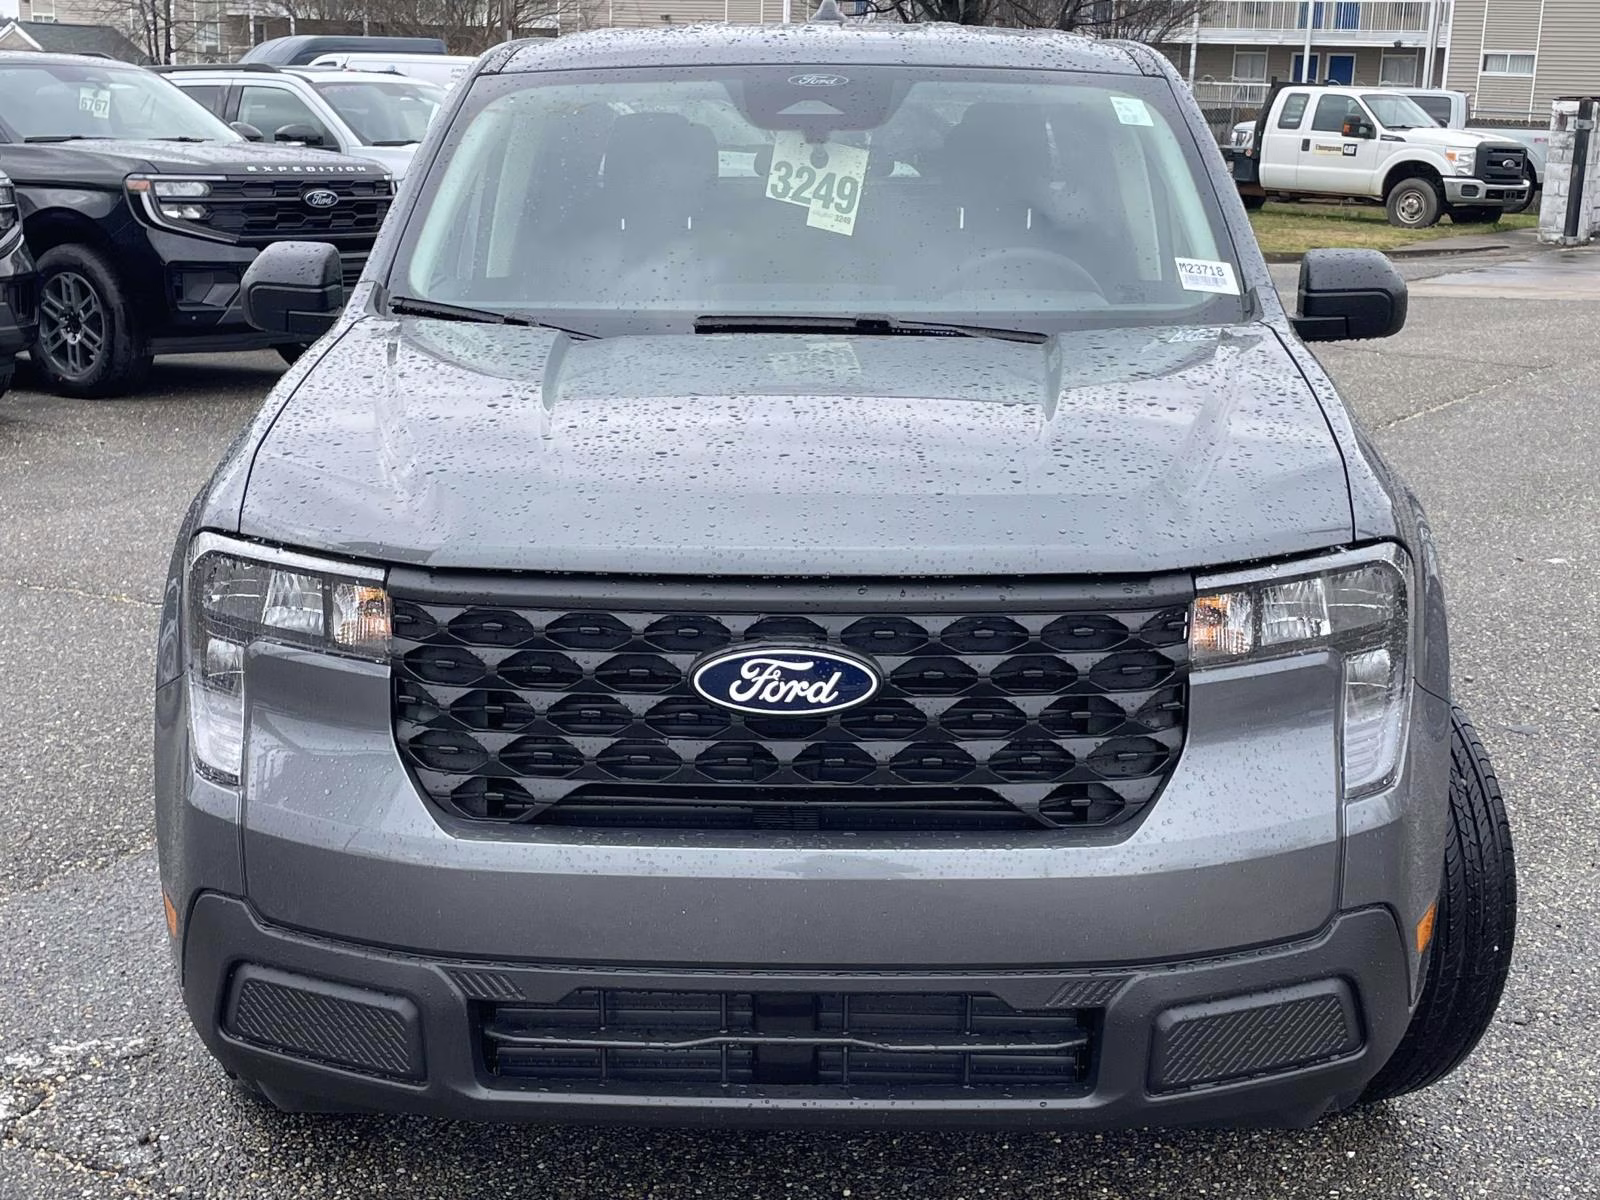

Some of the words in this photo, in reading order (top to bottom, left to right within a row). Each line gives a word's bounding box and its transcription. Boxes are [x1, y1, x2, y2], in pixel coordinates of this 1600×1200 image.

[797, 73, 838, 86] Ford
[81, 96, 109, 112] 6767
[246, 165, 367, 173] EXPEDITION
[770, 160, 859, 215] 3249
[1178, 262, 1225, 277] M23718
[728, 657, 843, 705] Ford
